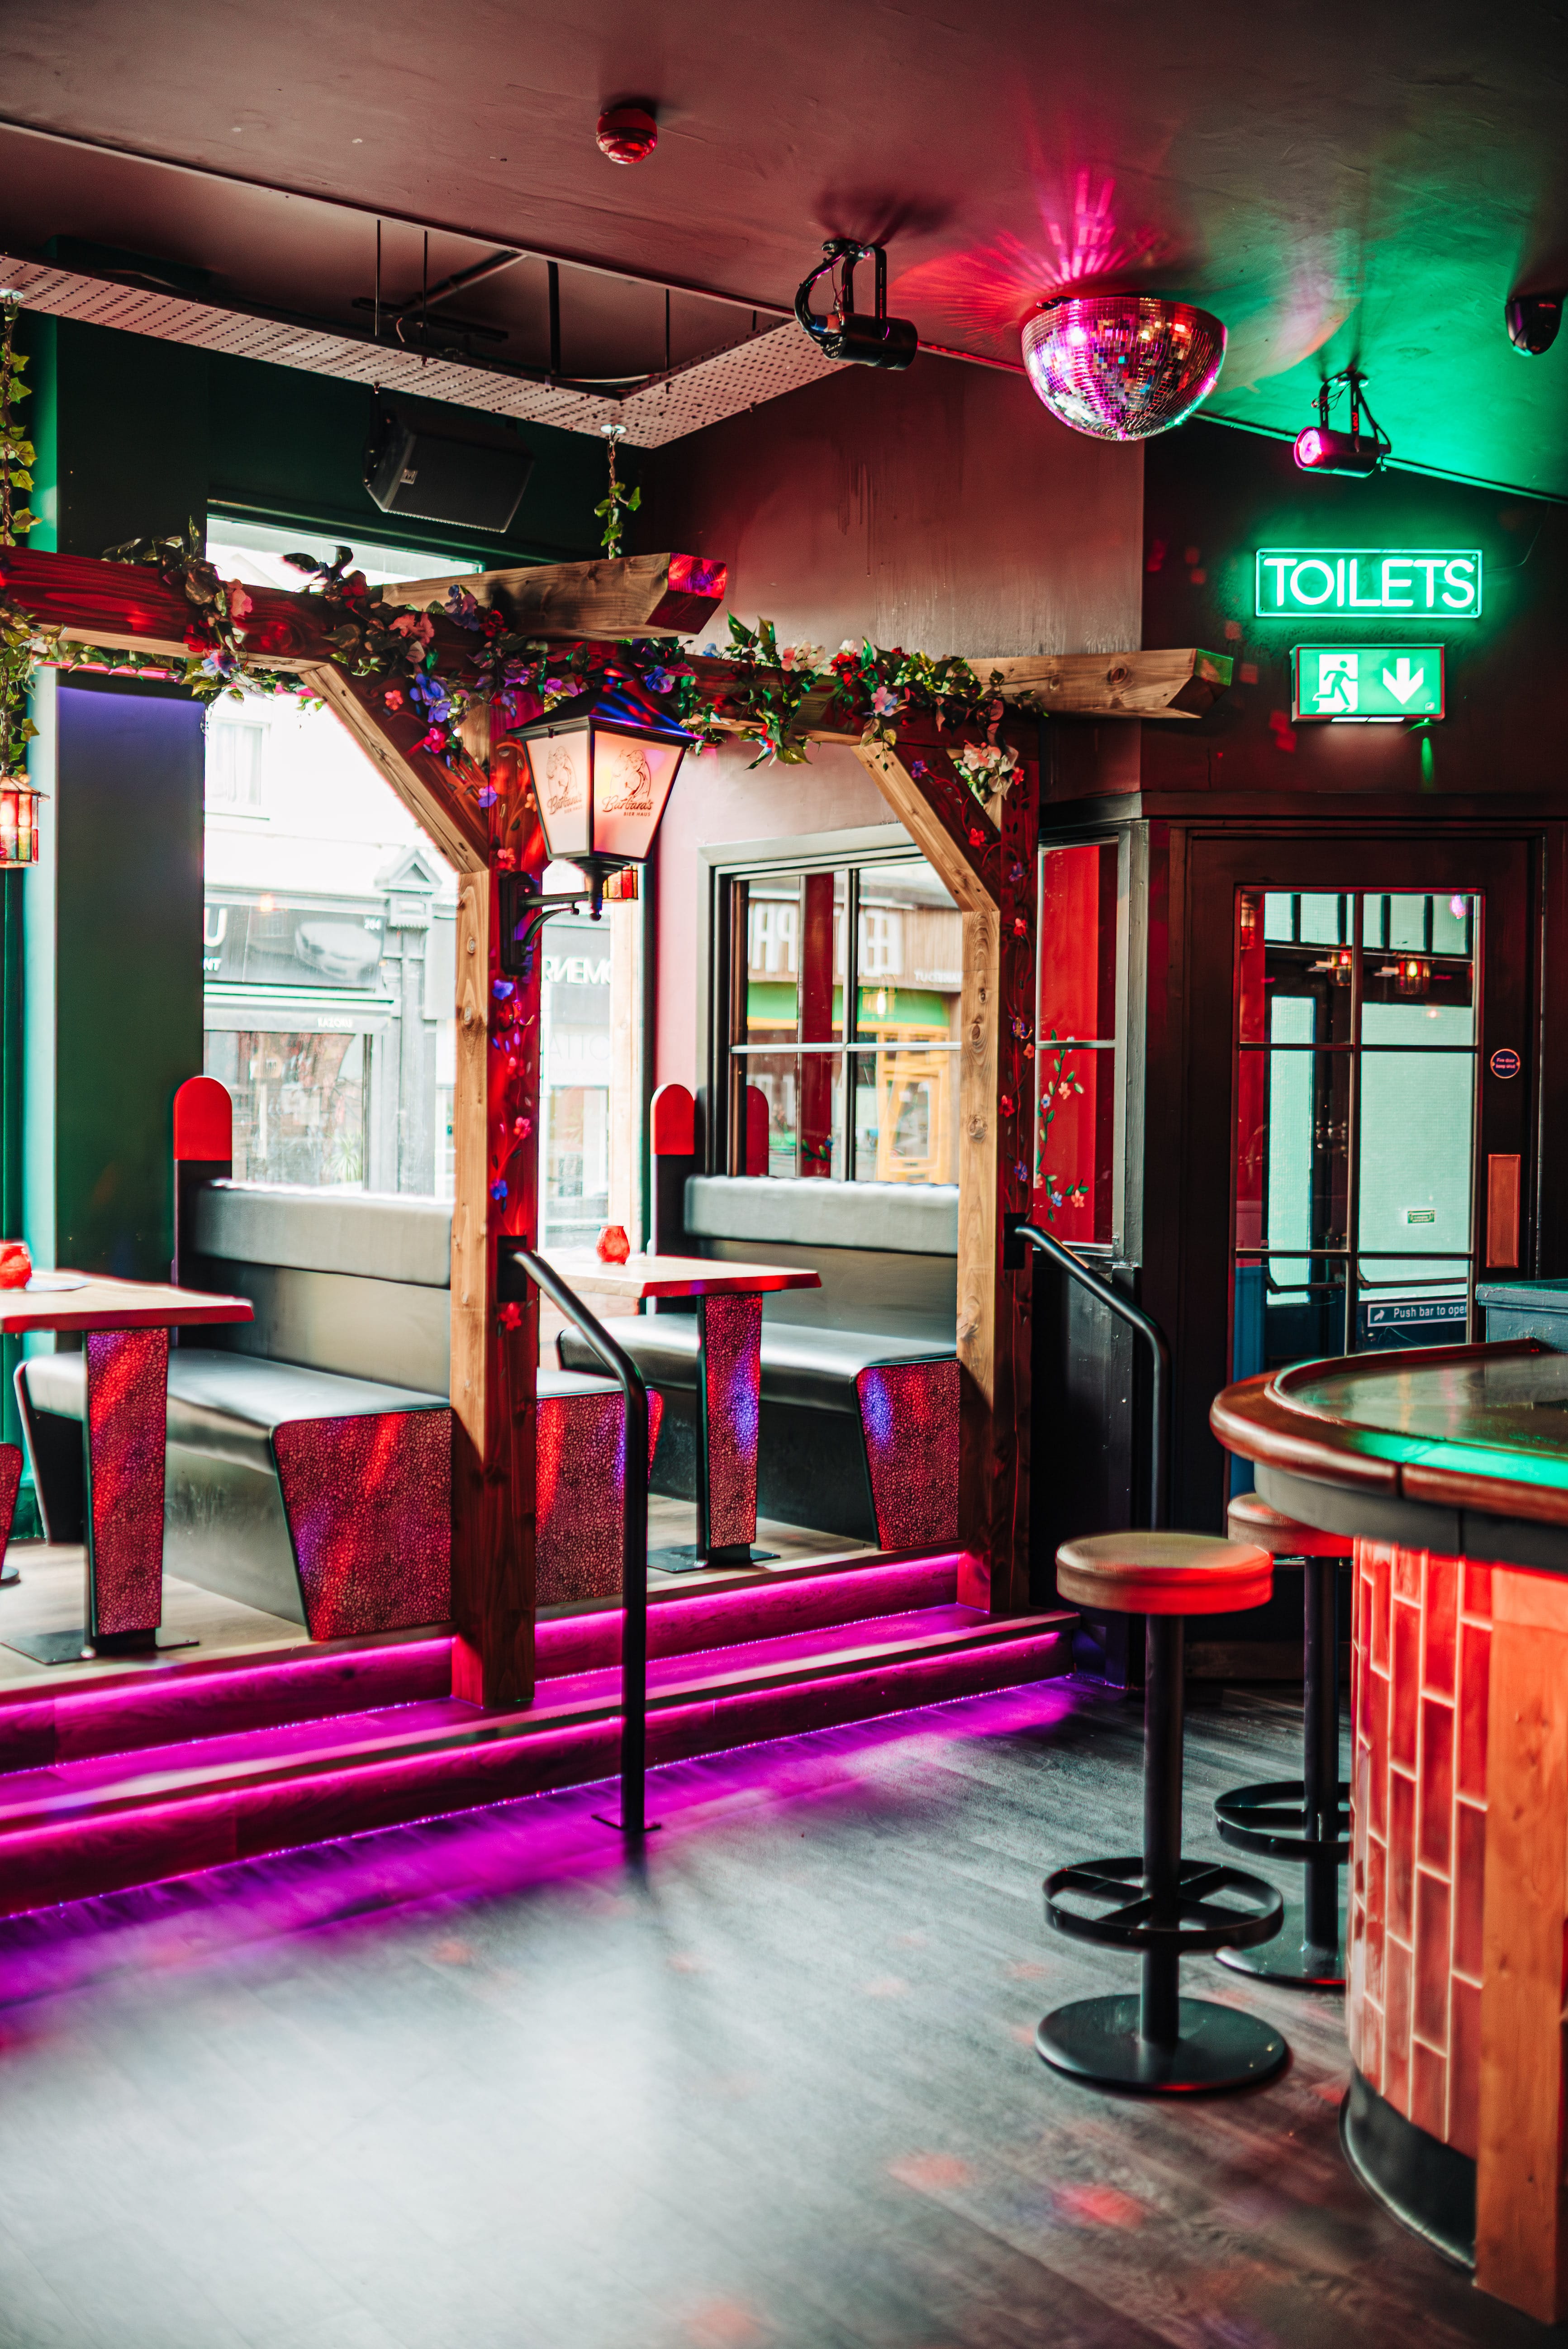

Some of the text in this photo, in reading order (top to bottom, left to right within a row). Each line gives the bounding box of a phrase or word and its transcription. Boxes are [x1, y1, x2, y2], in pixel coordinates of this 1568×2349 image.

[1264, 558, 1475, 609] TOILETS
[547, 793, 582, 815] Barbara's
[602, 795, 653, 813] Barbara's
[1393, 1307, 1416, 1318] Push
[1419, 1306, 1434, 1317] bar
[1437, 1306, 1445, 1316] to
